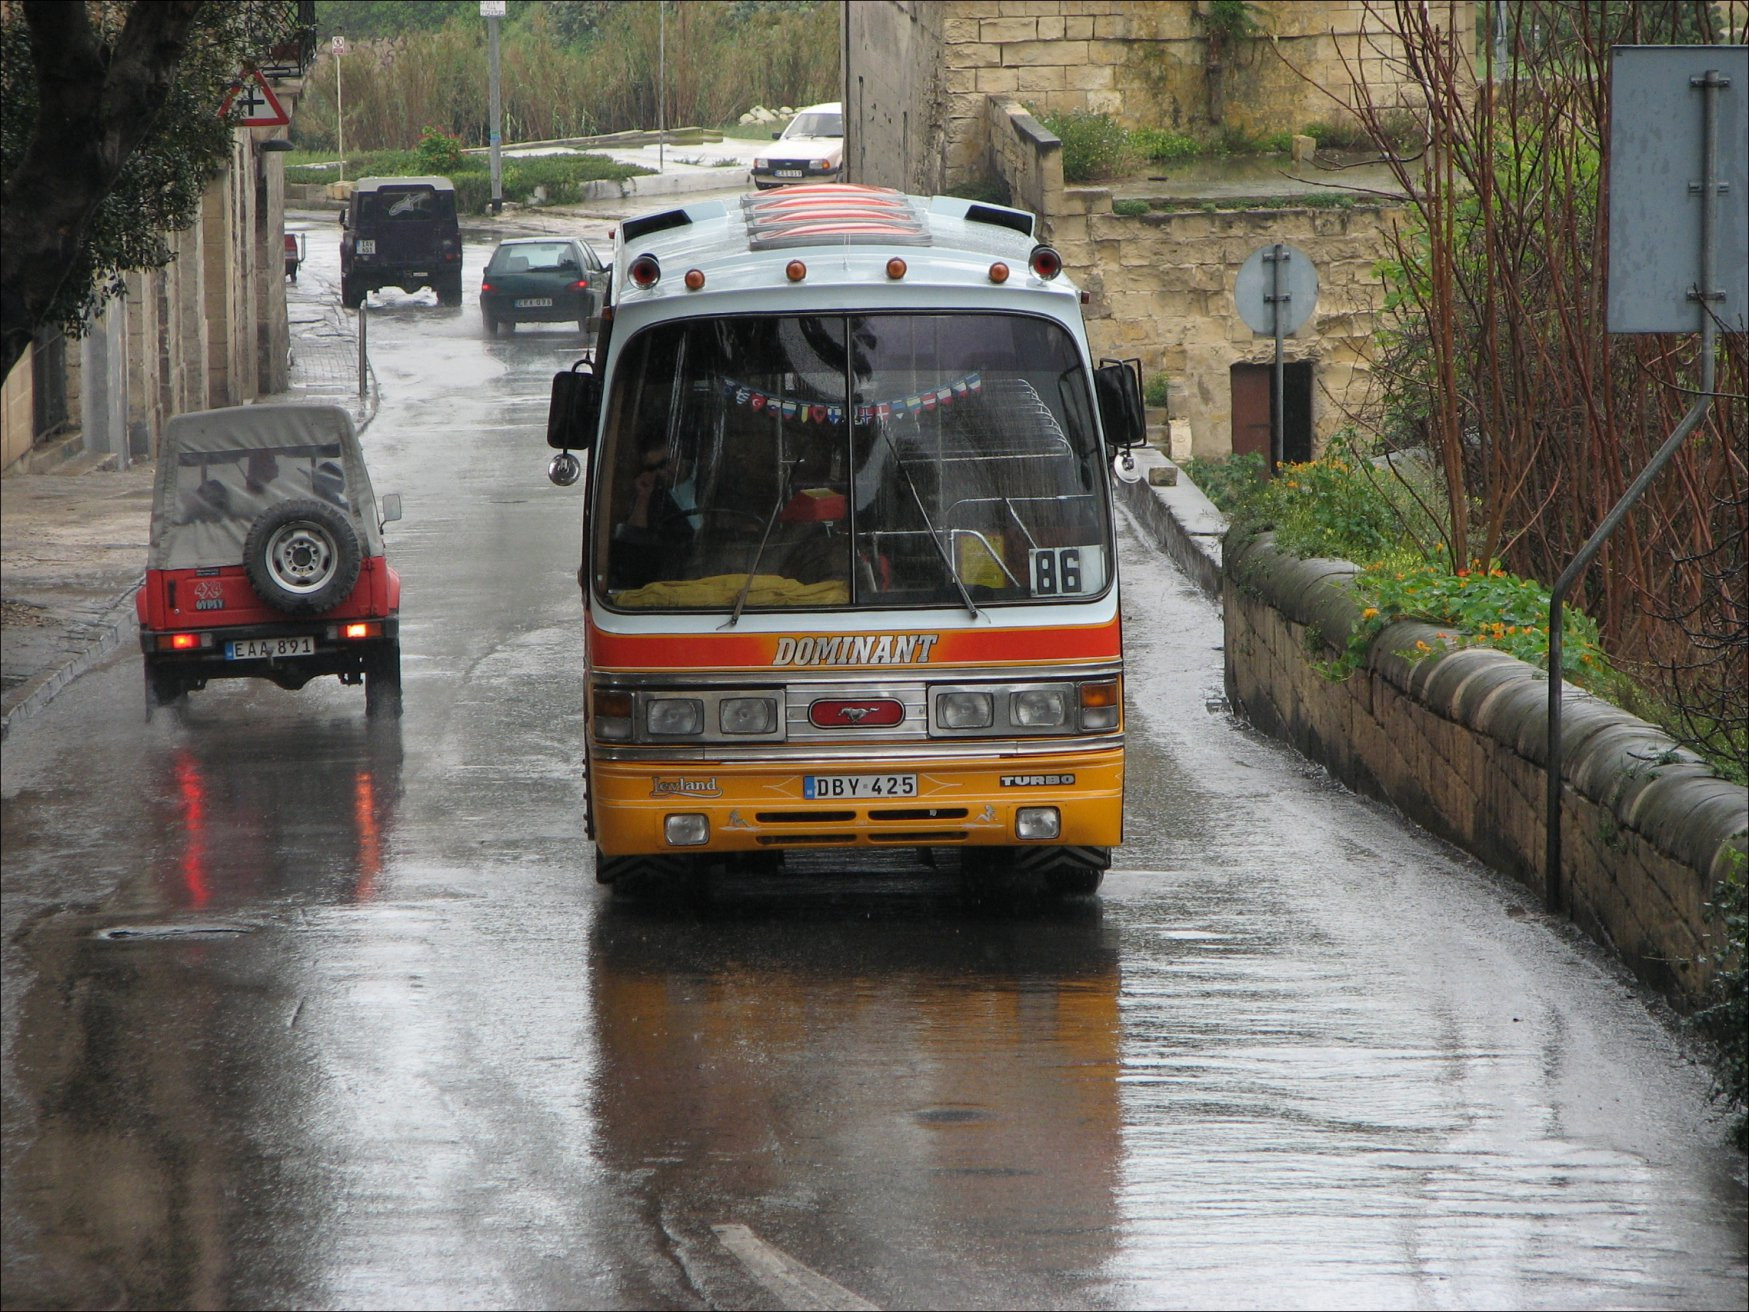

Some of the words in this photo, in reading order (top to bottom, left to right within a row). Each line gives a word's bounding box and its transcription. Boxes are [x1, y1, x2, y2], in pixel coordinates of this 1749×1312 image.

[1036, 549, 1082, 594] 86
[234, 641, 269, 657] EAA
[277, 639, 312, 655] 891
[772, 634, 939, 666] DOMINANT
[650, 776, 722, 798] Leyland
[817, 778, 860, 797] DBY
[871, 776, 914, 795] 425
[1001, 775, 1075, 786] TURBO
